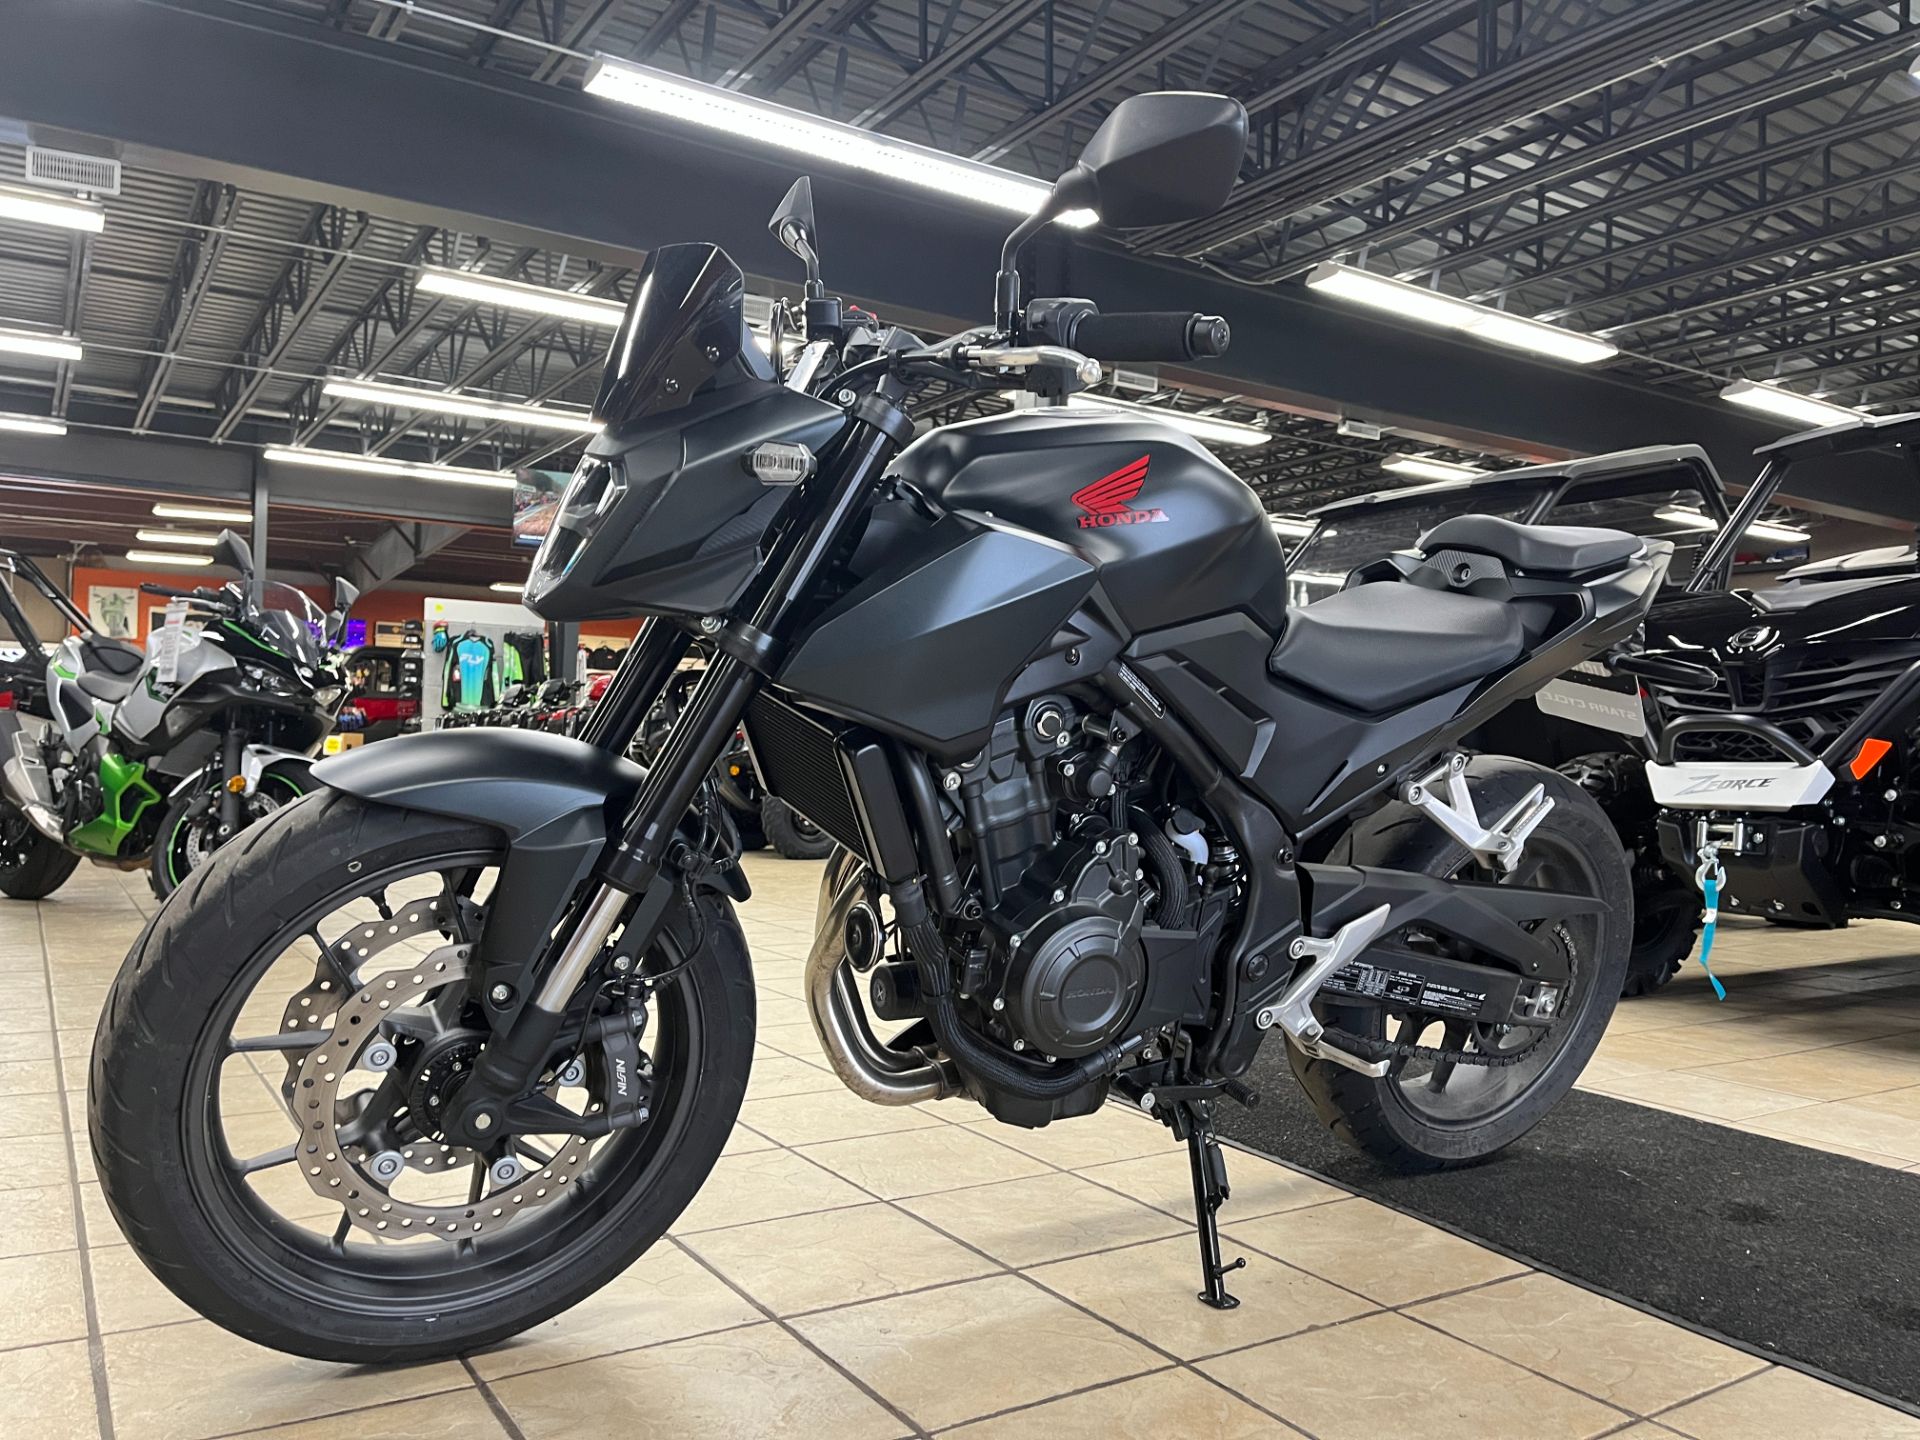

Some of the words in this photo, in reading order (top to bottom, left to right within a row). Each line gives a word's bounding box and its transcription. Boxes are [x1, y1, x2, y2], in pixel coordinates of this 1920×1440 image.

[1078, 508, 1170, 529] HONDA
[460, 653, 485, 665] FLY
[1674, 774, 1778, 797] ZFORCE
